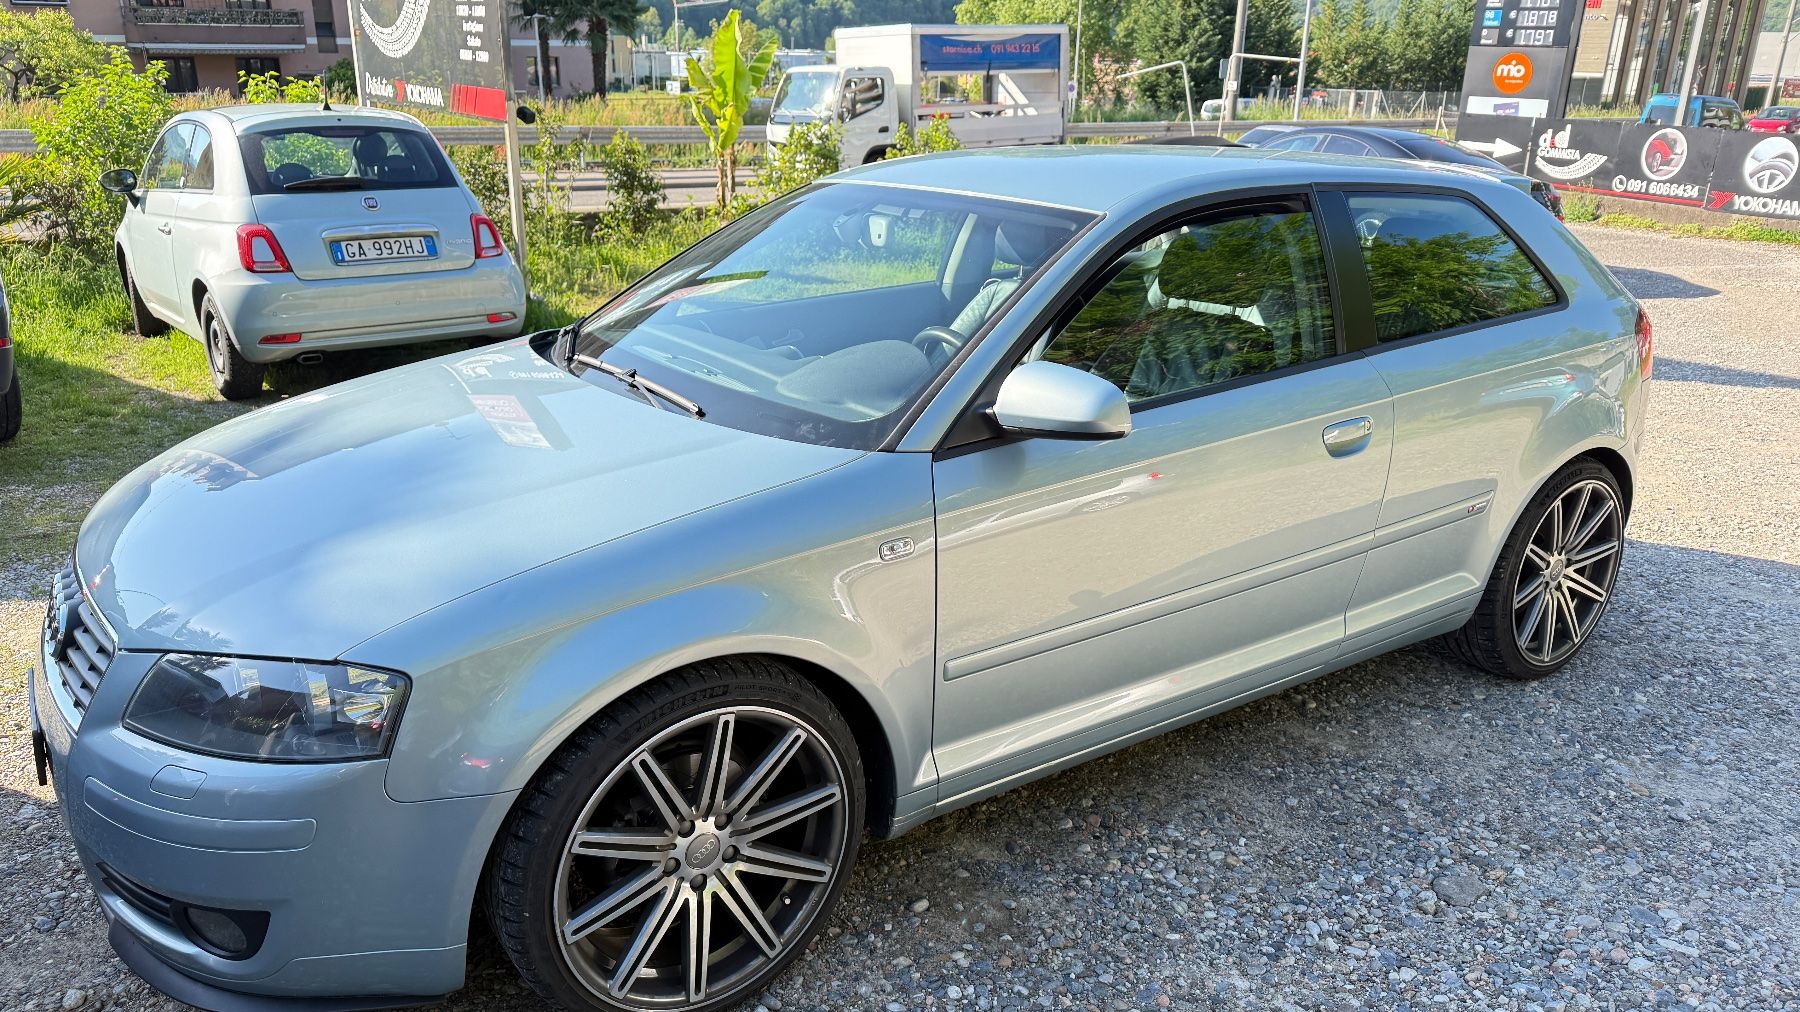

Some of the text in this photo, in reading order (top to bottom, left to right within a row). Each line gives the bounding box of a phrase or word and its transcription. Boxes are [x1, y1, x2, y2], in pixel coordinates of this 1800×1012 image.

[1496, 60, 1526, 78] mio
[405, 84, 444, 107] YOKOHAMA
[1537, 146, 1581, 161] GOMMISTA
[1627, 179, 1700, 199] 091 6066434
[344, 239, 425, 259] GA 992HJ
